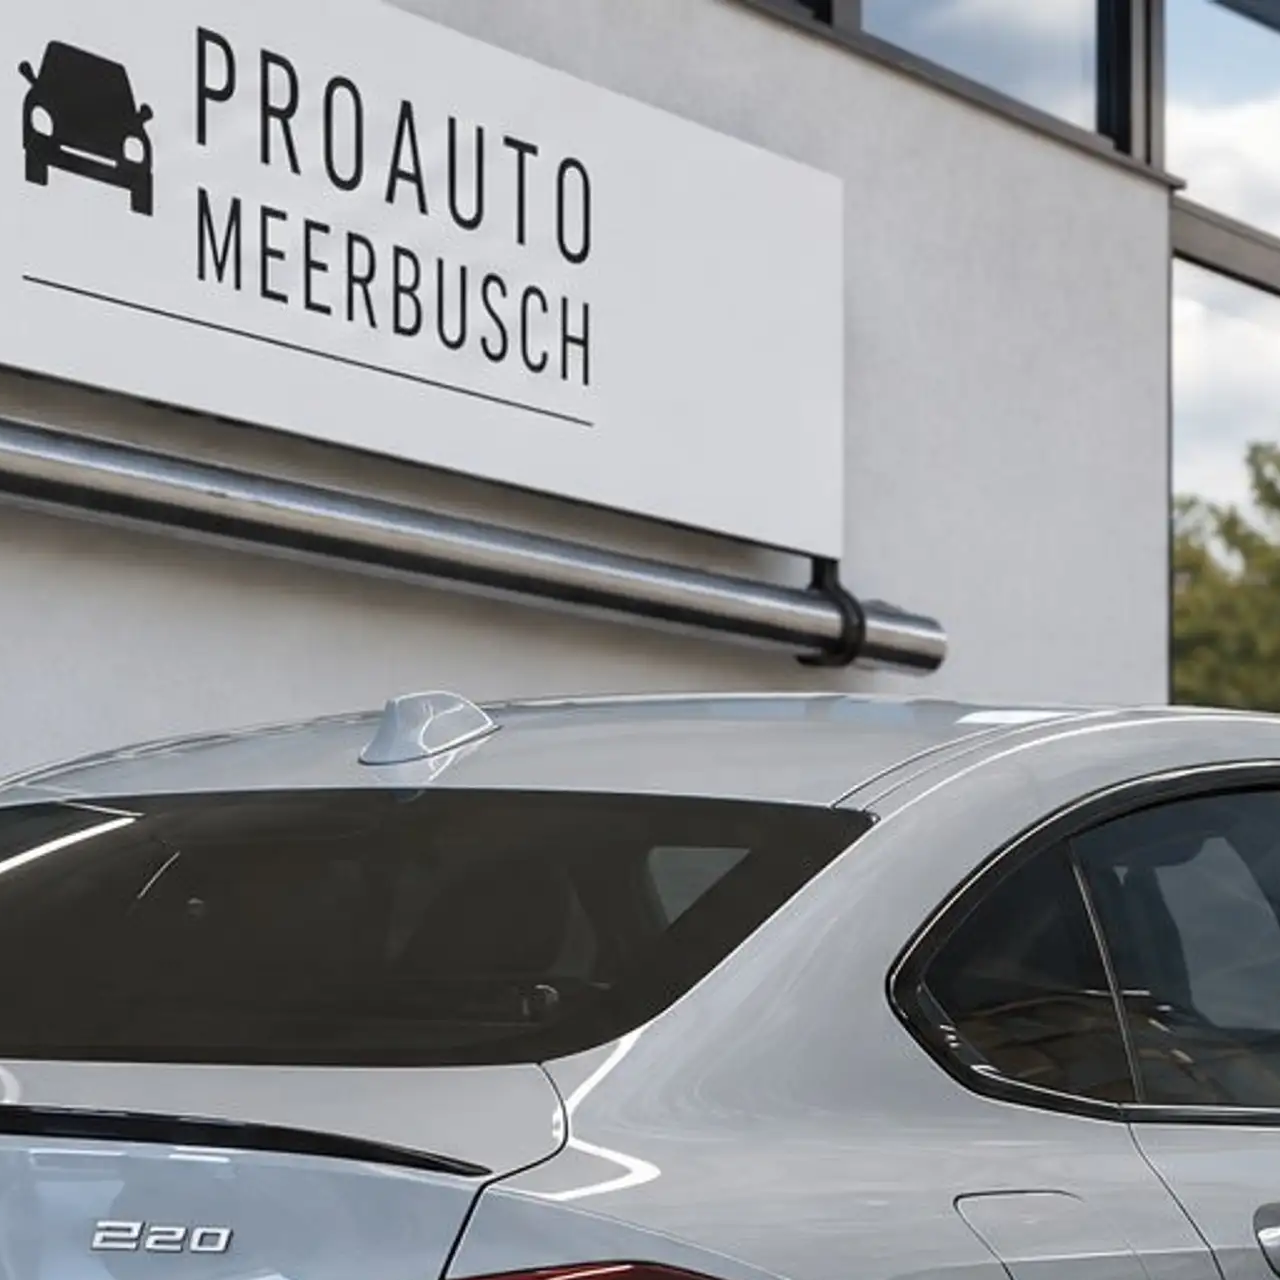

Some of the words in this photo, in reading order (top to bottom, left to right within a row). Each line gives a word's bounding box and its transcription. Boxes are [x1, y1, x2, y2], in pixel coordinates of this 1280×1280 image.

[196, 26, 591, 265] PROAUTO
[197, 186, 590, 386] MEERBUSCH
[91, 1220, 233, 1253] 220
